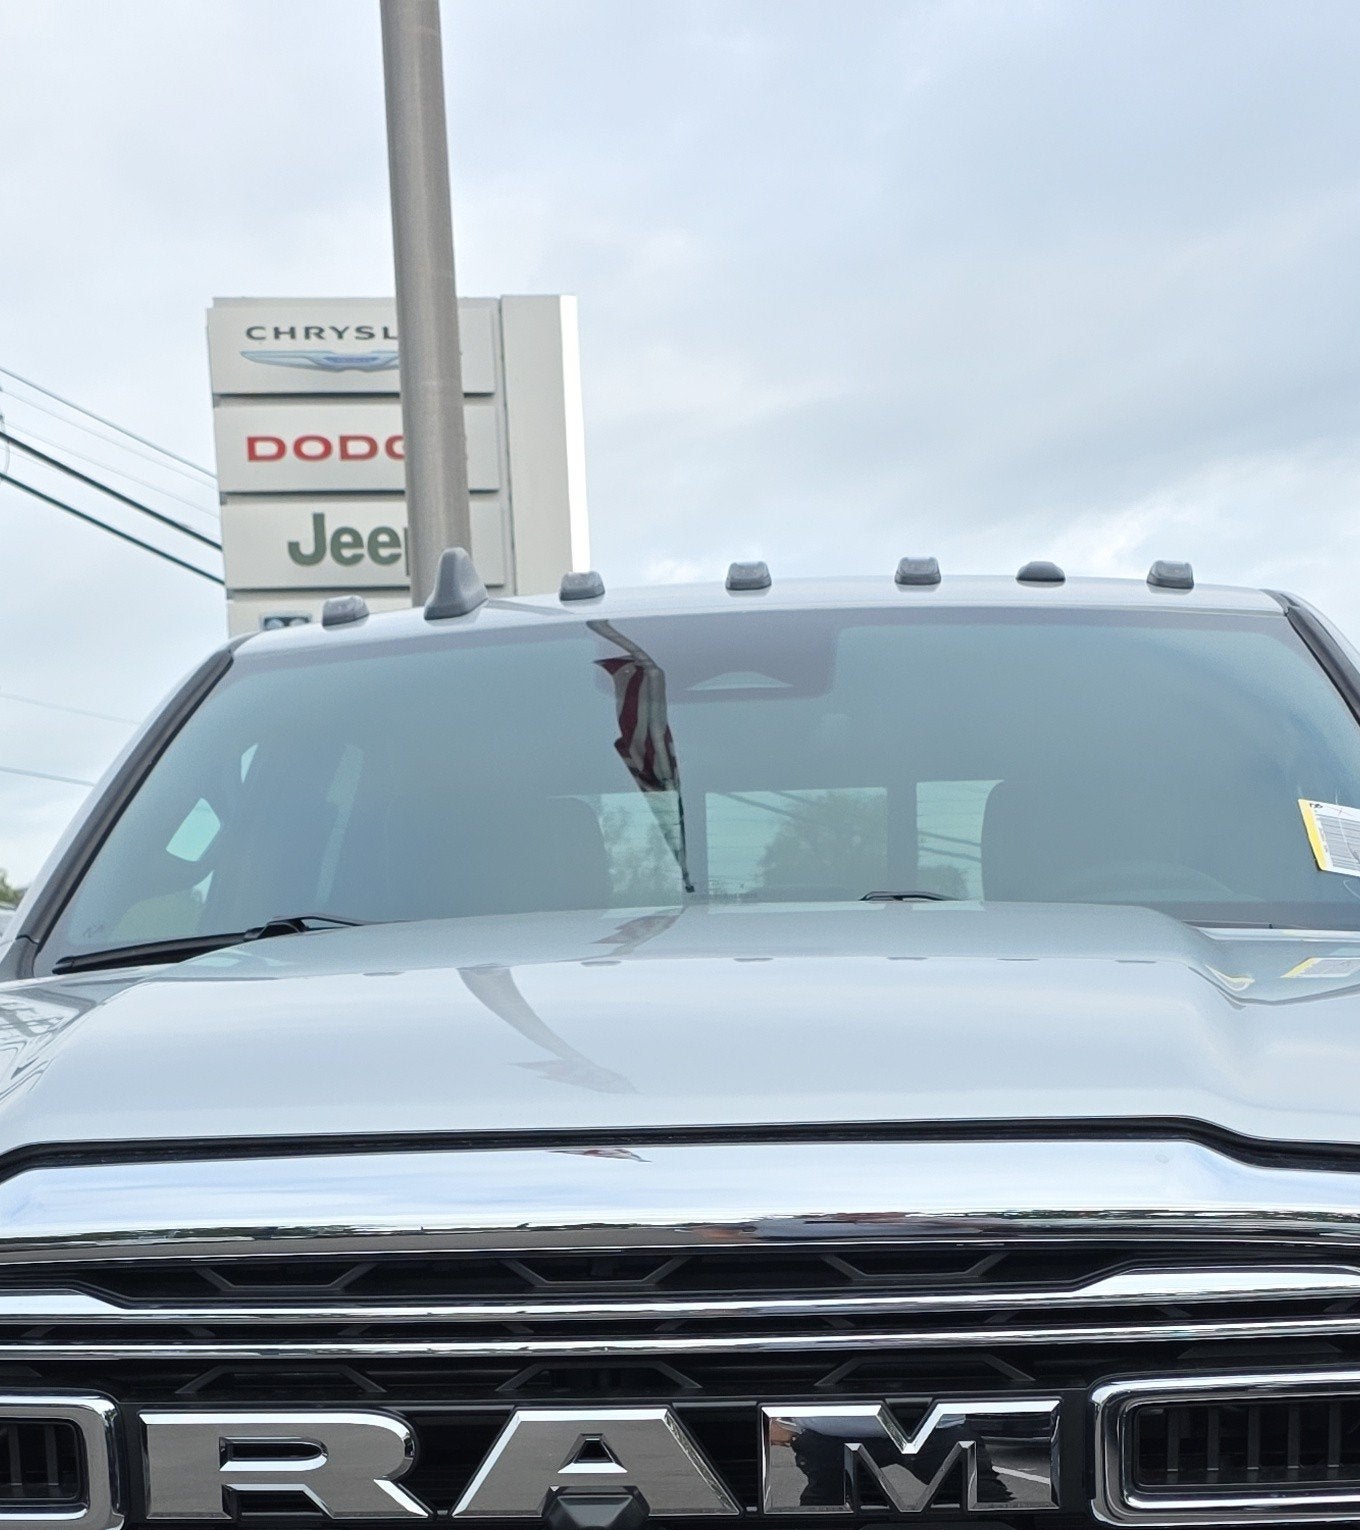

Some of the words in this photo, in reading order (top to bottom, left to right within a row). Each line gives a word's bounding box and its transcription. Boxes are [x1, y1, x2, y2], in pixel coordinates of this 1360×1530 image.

[245, 325, 399, 341] CHRYSL
[245, 434, 405, 463] DOD
[287, 512, 410, 576] Jee
[138, 1400, 1062, 1521] RAM
